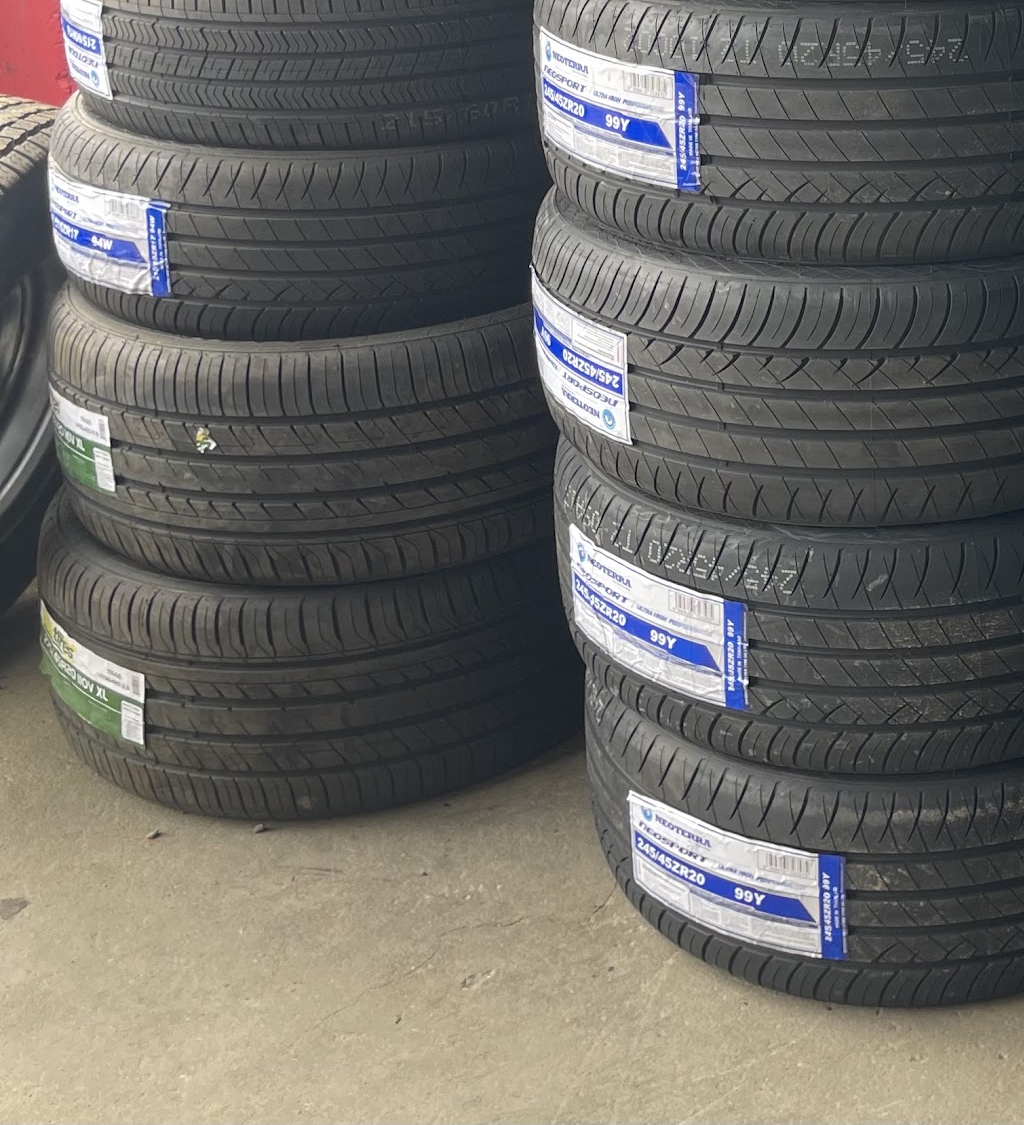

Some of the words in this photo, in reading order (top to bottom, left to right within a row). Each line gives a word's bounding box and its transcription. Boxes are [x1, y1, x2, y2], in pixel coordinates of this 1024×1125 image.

[552, 50, 589, 75] NEOTERRA
[543, 82, 585, 118] 245/45ZR20
[605, 113, 631, 132] 99Y
[677, 91, 687, 112] 99Y
[679, 115, 688, 171] 245/45ZR20
[91, 235, 113, 251] 94W
[562, 348, 621, 389] 245/45ZR20
[586, 553, 632, 589] NEOTERRA
[650, 629, 677, 650] 99Y
[726, 618, 736, 639] 99Y
[95, 684, 109, 702] XL
[654, 814, 711, 849] NEOTERRA
[636, 836, 706, 887] 245/45ZR20
[733, 886, 767, 906] 99Y
[821, 871, 831, 891] 99Y
